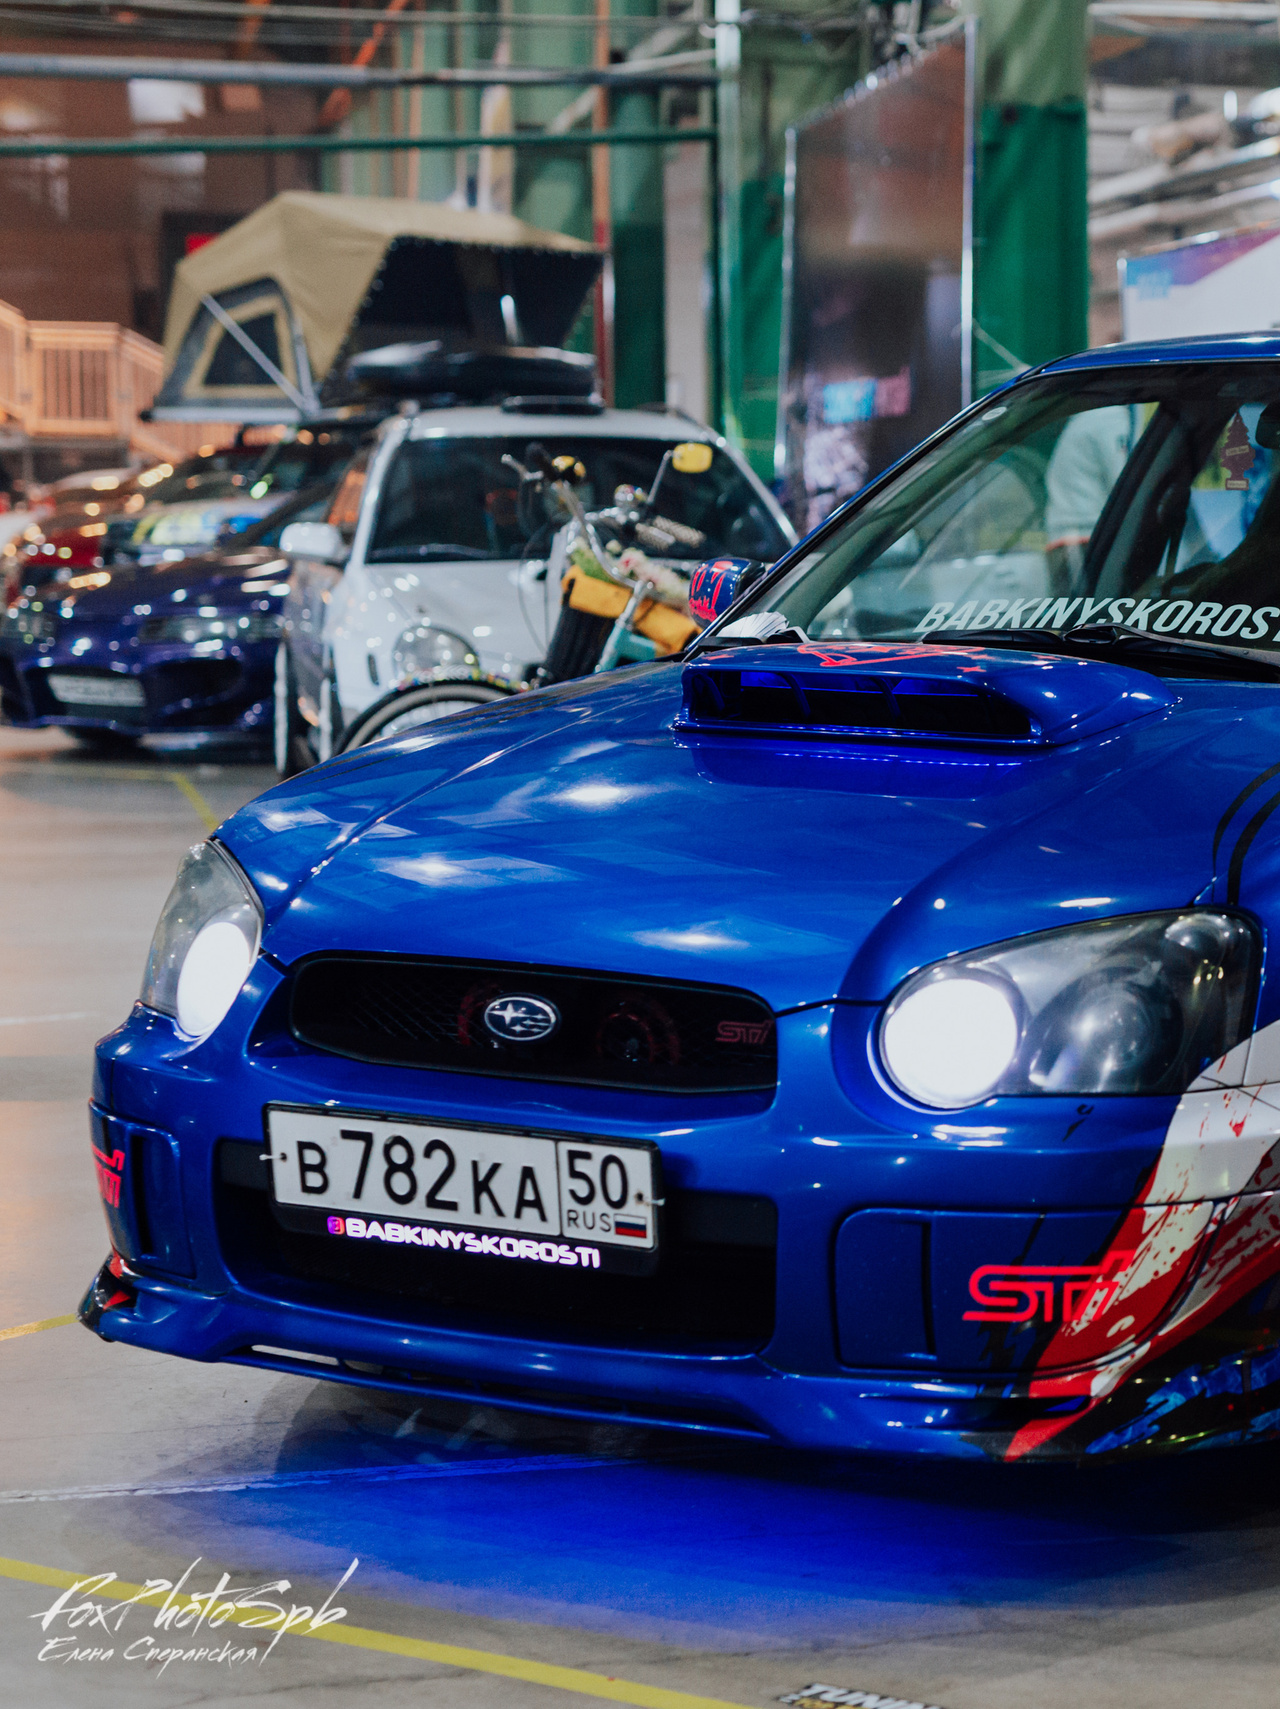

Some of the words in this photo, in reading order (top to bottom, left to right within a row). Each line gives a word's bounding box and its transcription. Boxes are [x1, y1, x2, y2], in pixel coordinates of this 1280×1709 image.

[566, 1149, 629, 1210] 50
[345, 1217, 601, 1269] BABKINYSKOROSTI
[566, 1208, 612, 1233] RUS
